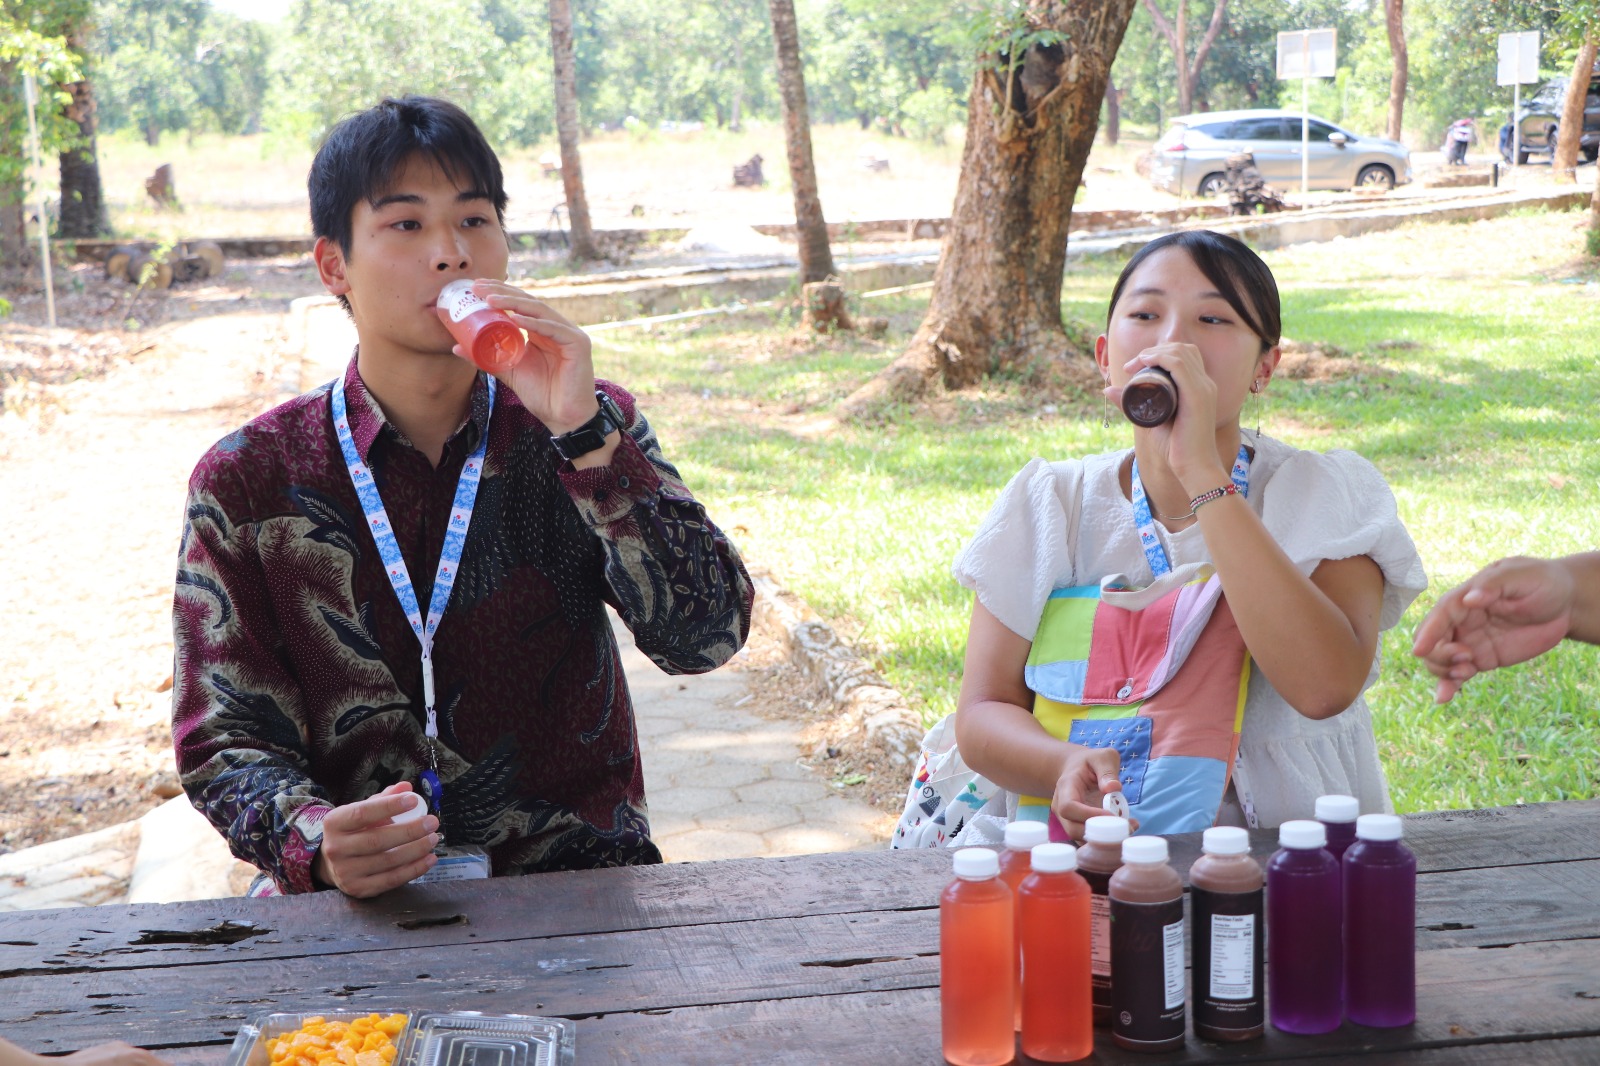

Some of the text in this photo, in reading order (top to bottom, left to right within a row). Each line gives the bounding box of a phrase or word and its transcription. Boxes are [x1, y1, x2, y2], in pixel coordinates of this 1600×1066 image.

[463, 463, 478, 474] JICA
[1233, 464, 1245, 475] JICA
[353, 470, 367, 482] JICA
[371, 519, 386, 532] JICA
[451, 514, 465, 526] JICA
[1141, 532, 1155, 544] JICA
[390, 570, 405, 583] JICA
[438, 567, 452, 579] JICA
